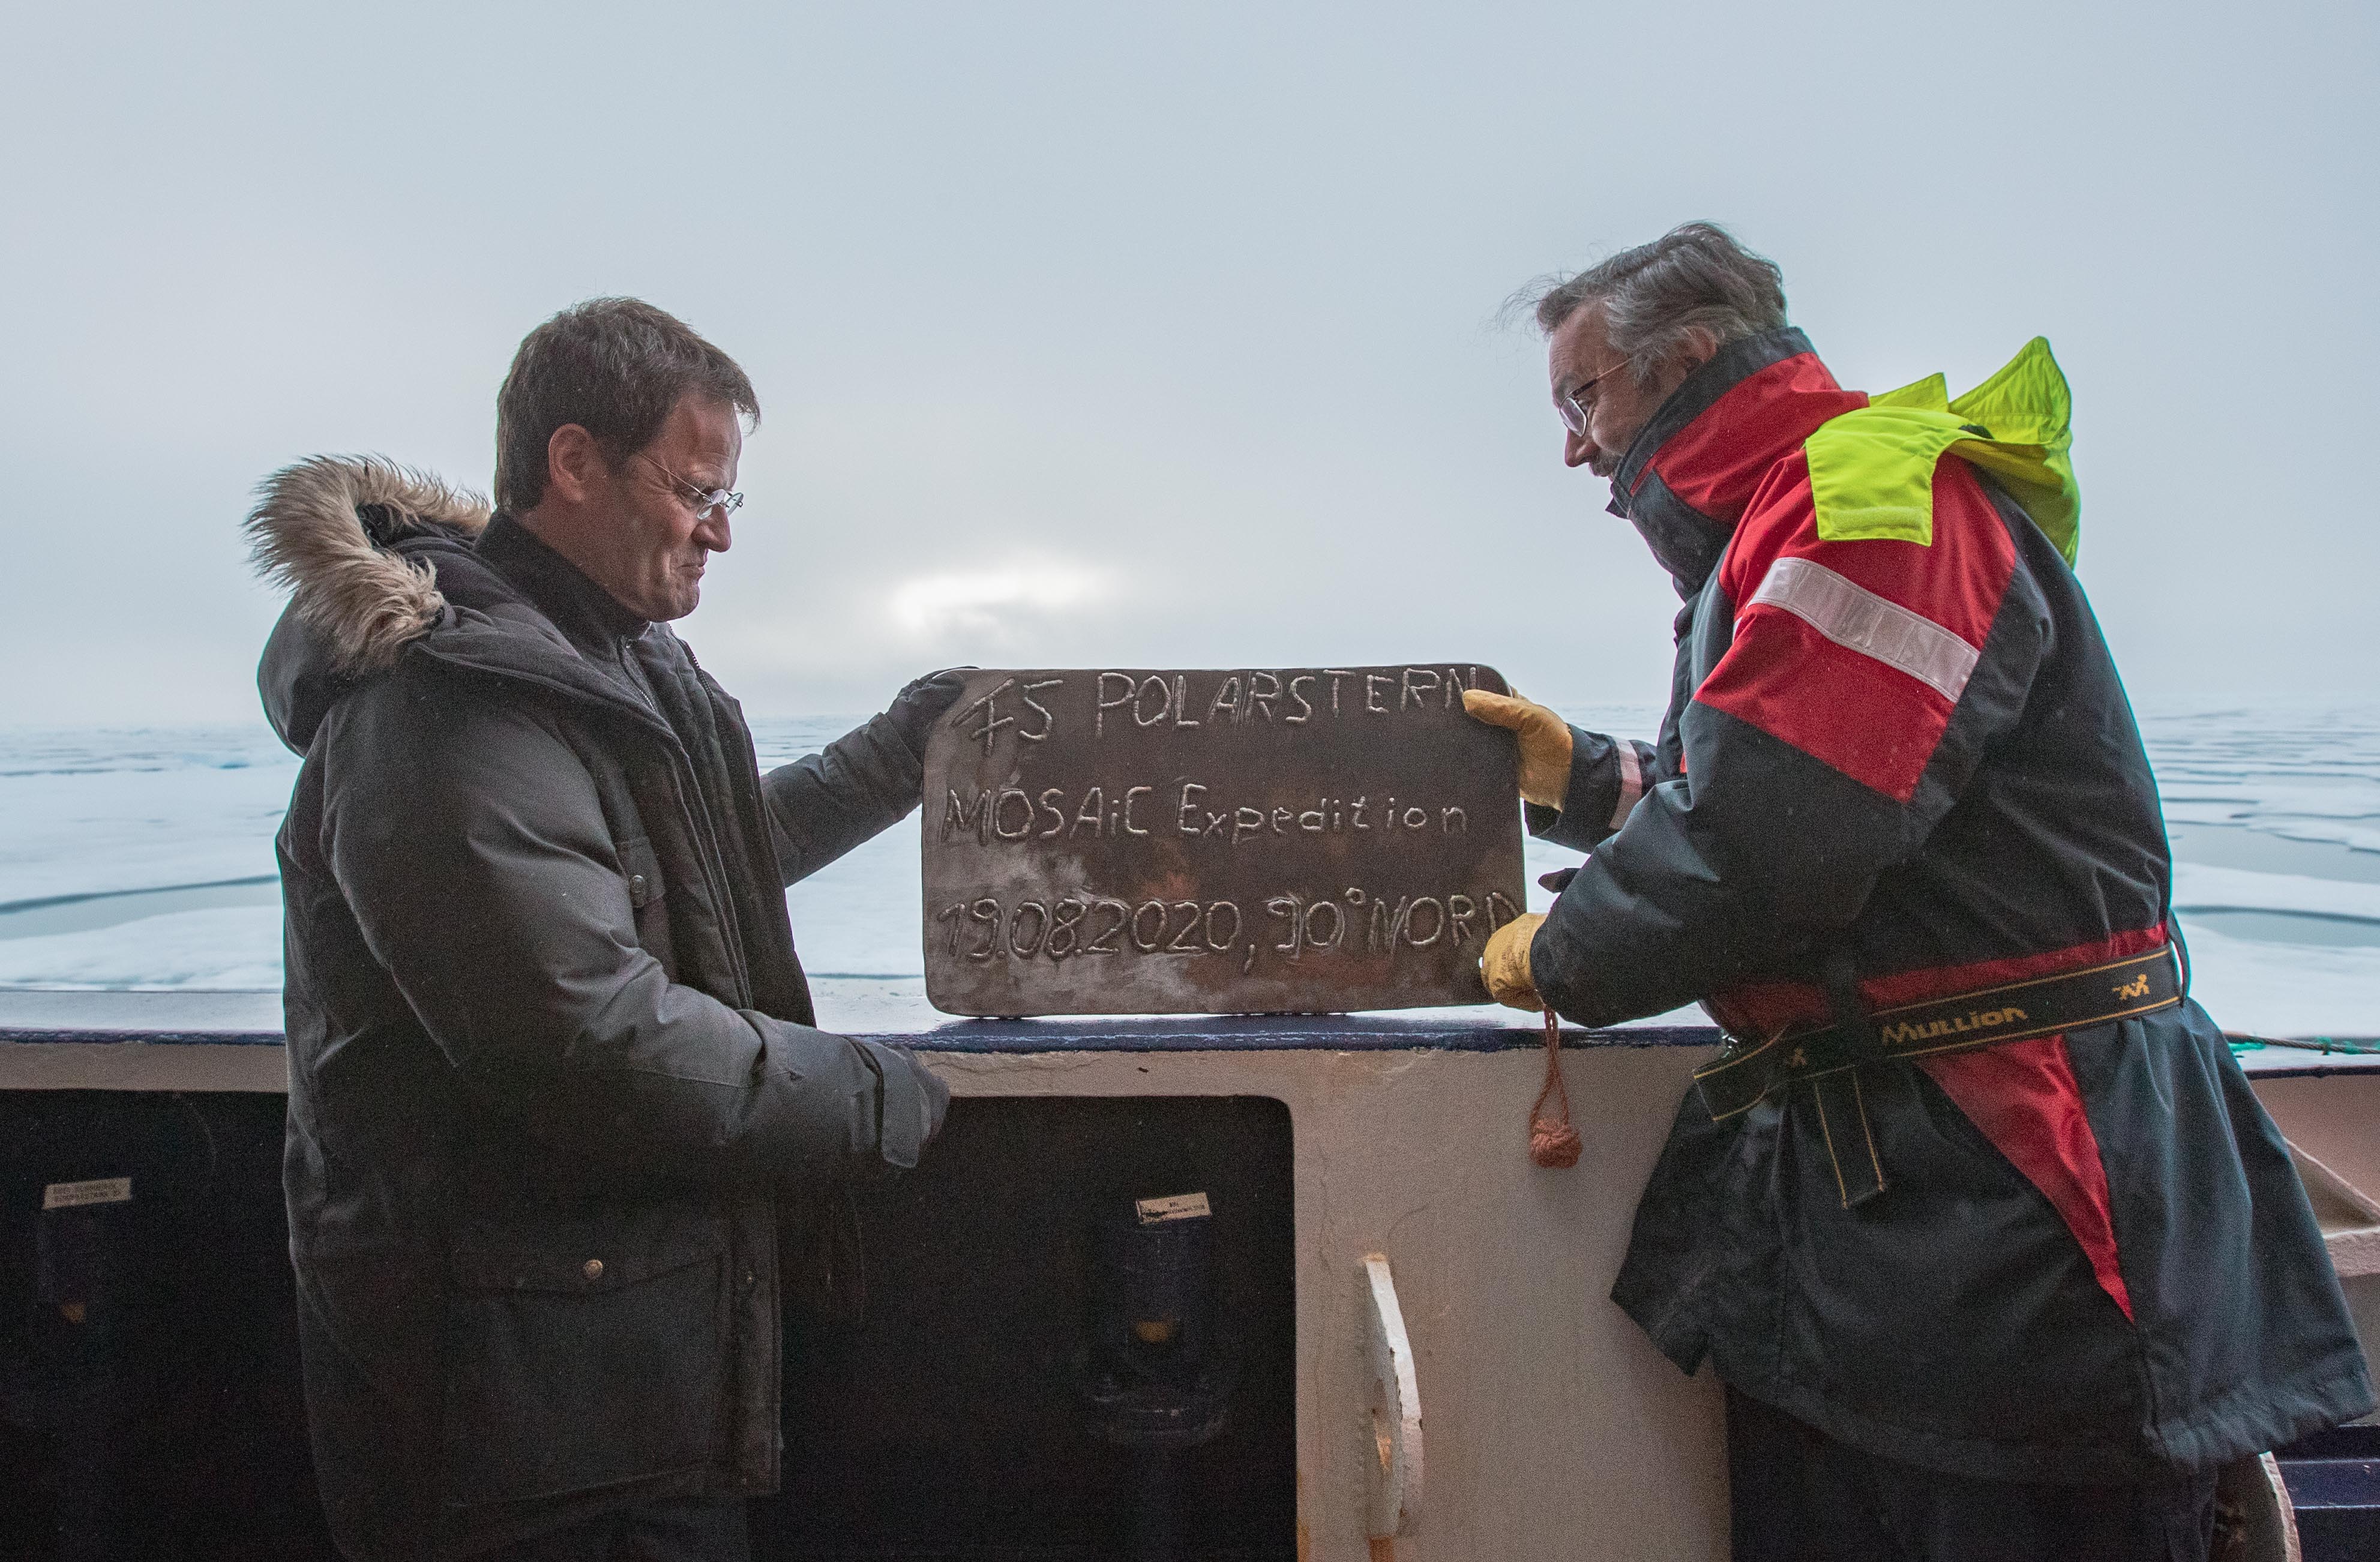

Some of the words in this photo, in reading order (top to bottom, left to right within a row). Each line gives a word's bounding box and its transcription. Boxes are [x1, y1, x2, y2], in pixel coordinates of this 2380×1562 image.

[951, 677, 1064, 756] FS
[1095, 667, 1477, 739] POLARSTERN
[940, 787, 1152, 847] MOSAiC
[1177, 783, 1468, 846] Expedition
